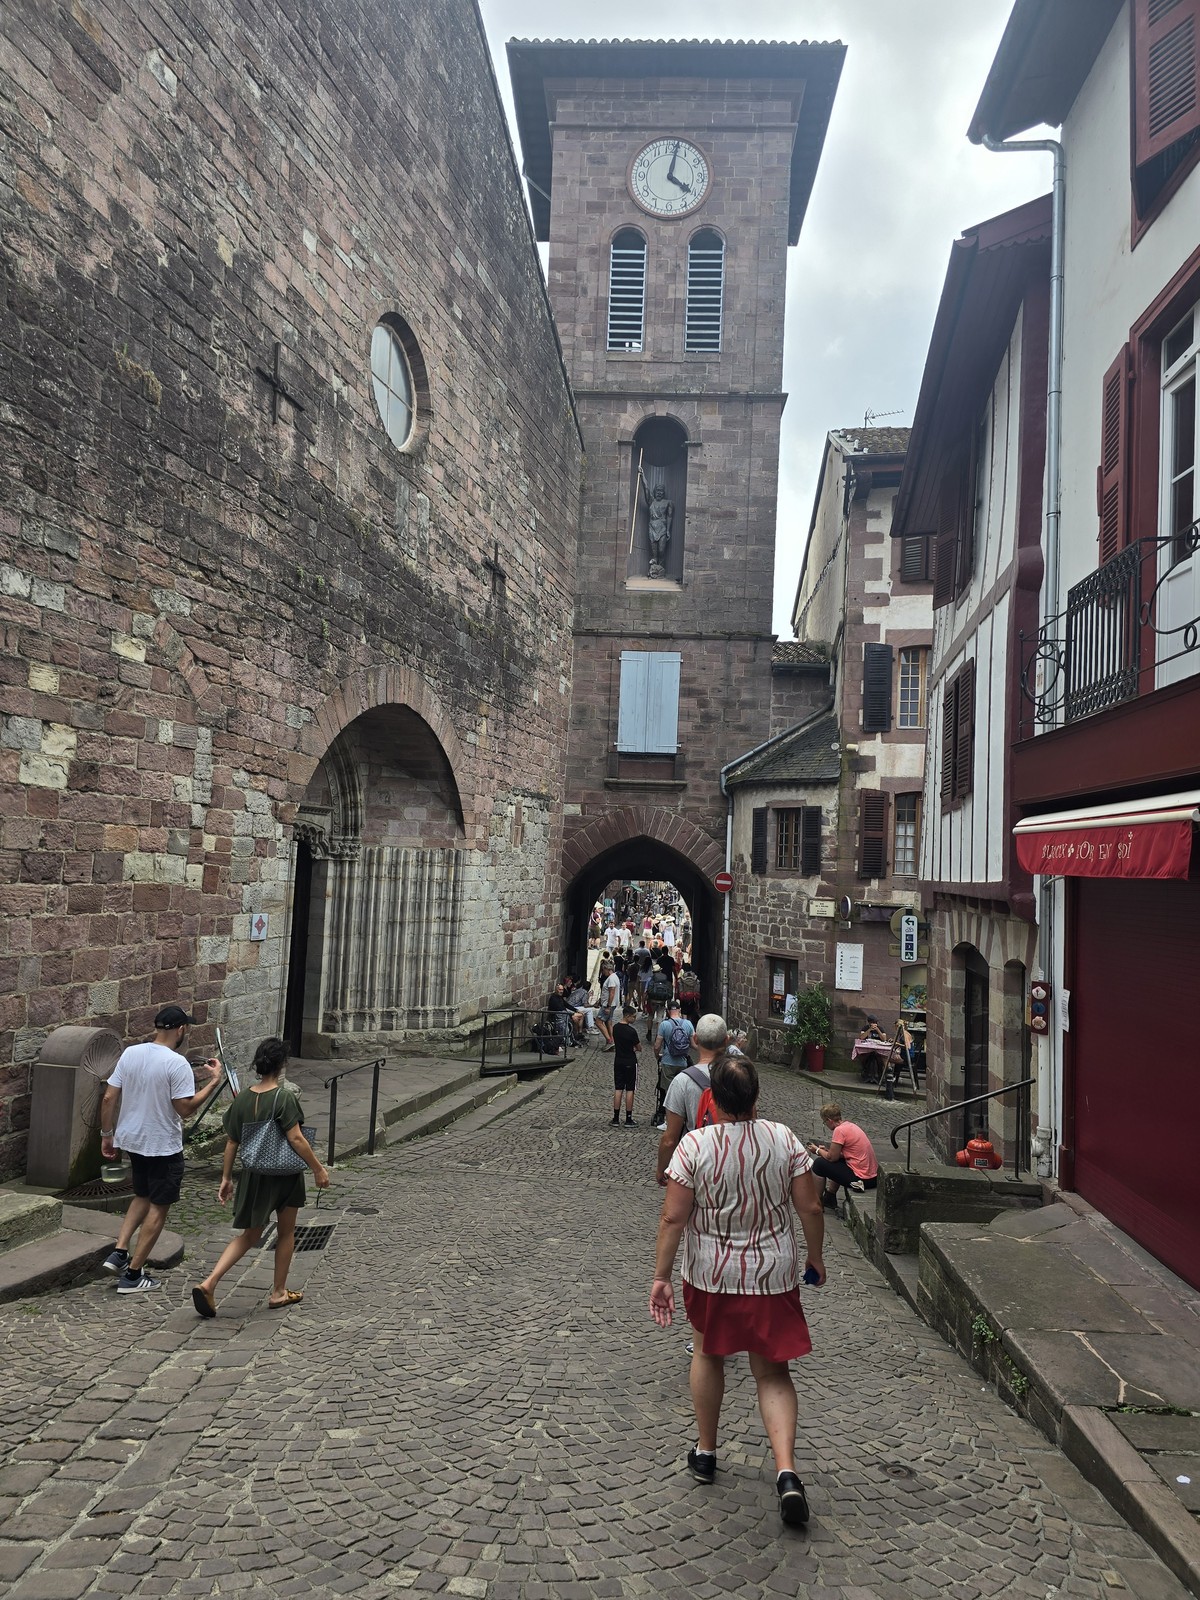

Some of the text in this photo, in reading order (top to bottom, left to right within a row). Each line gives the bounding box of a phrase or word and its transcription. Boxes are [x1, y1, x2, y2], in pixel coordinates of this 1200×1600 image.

[654, 147, 660, 158] 11
[683, 147, 687, 158] 1
[639, 158, 650, 168] 10
[692, 158, 701, 168] 2
[638, 171, 646, 181] 9
[696, 172, 704, 184] 3
[642, 185, 650, 197] 8
[690, 187, 697, 197] 4
[652, 197, 658, 208] 7
[665, 201, 673, 211] 6
[680, 197, 687, 208] 5
